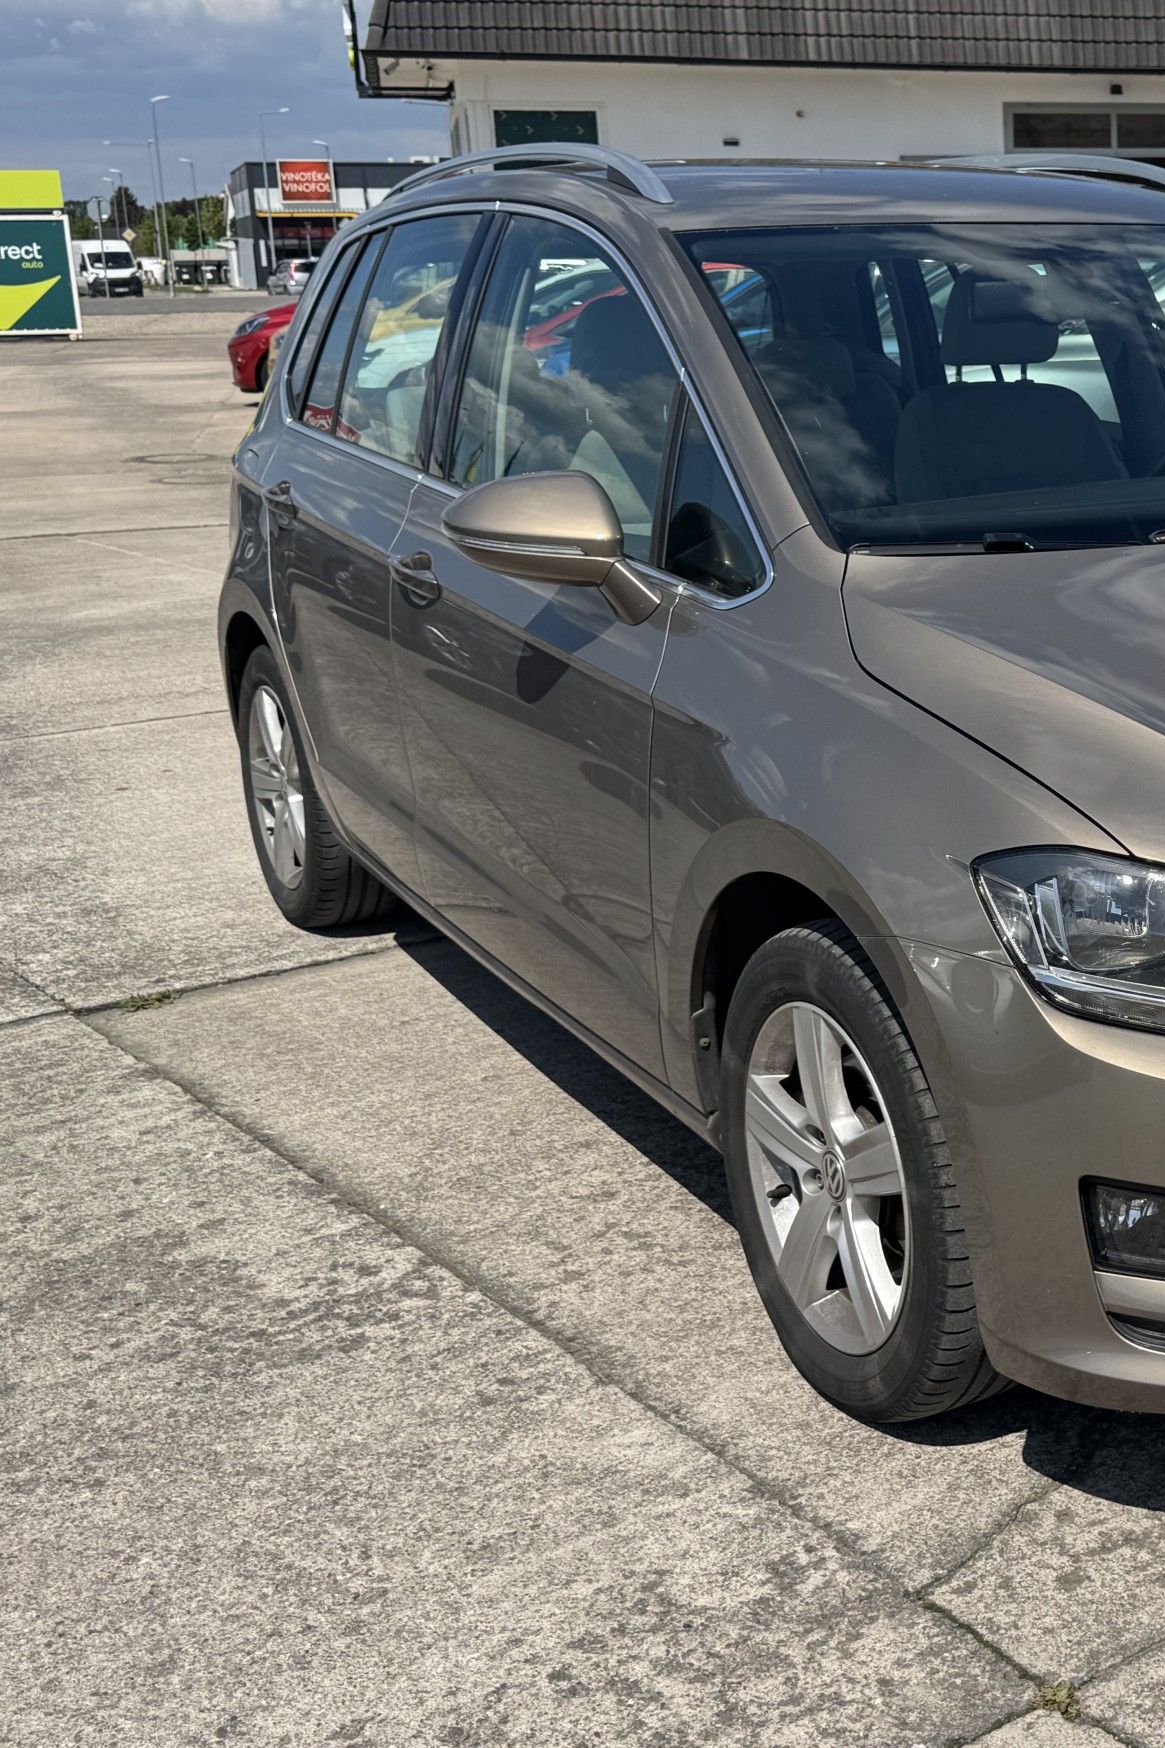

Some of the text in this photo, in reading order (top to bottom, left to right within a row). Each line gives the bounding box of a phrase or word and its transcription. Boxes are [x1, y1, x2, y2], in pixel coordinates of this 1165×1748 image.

[281, 171, 331, 182] VINOTÉKA
[283, 182, 331, 193] VINOFOL
[21, 261, 44, 269] auto
